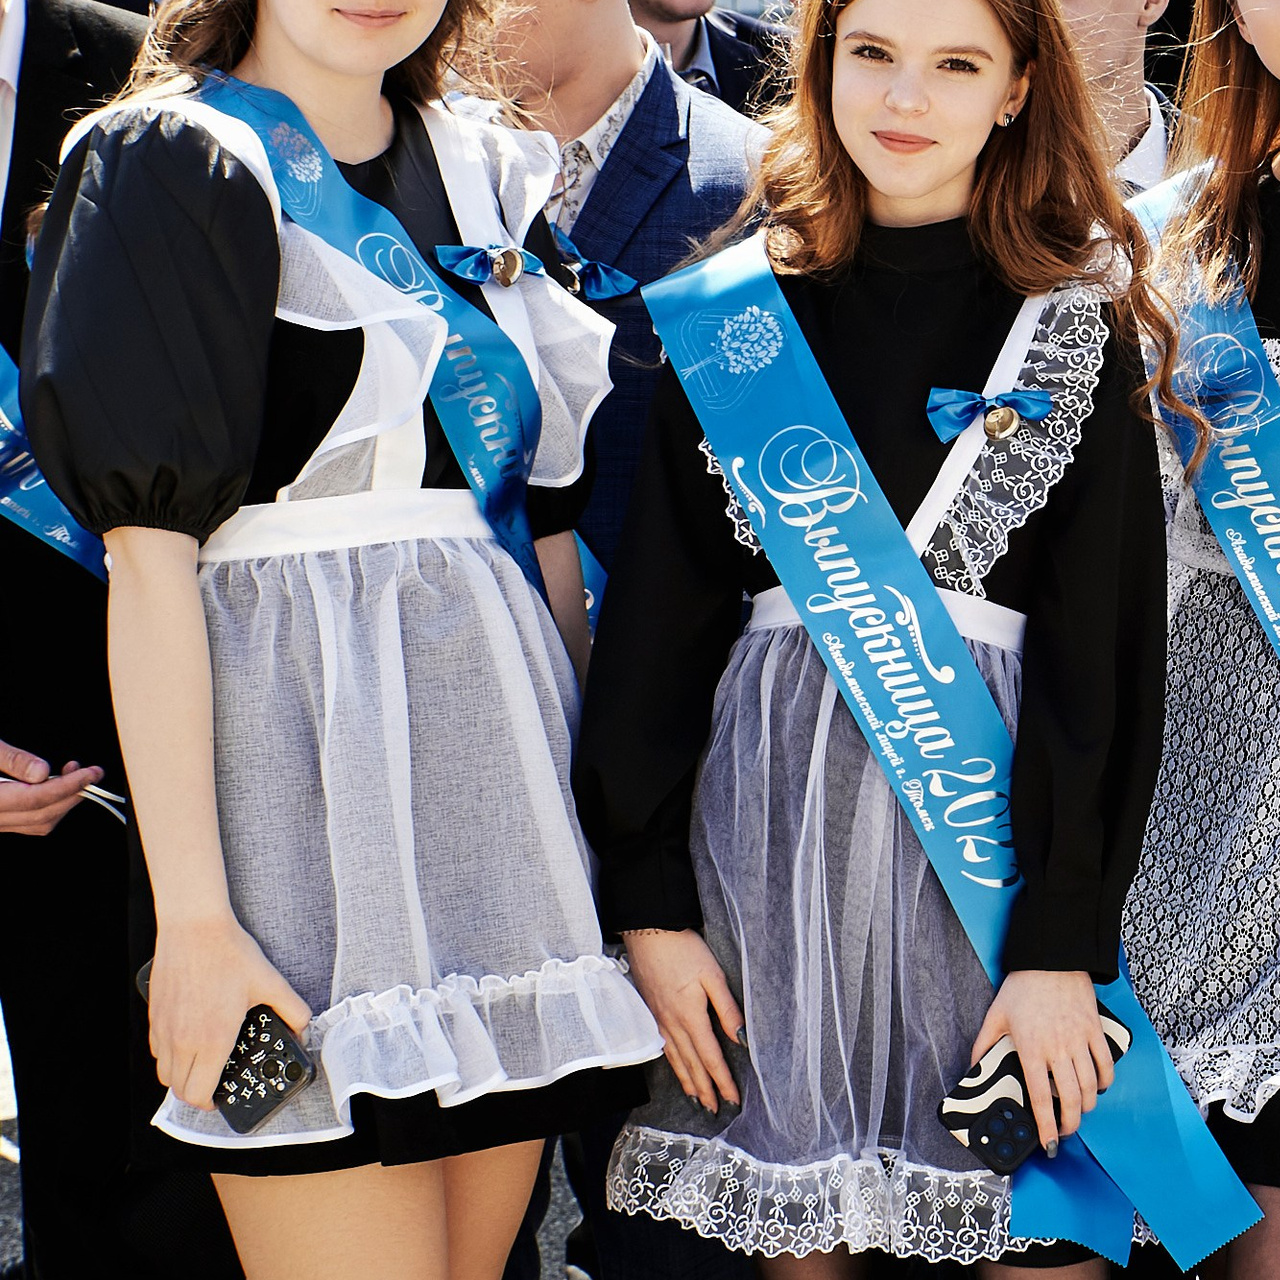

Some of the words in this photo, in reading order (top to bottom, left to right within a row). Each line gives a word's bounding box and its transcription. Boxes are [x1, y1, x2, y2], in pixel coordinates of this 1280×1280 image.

[758, 425, 956, 760] Выпускница
[1226, 528, 1280, 622] Академический
[822, 631, 884, 731] Академический
[875, 732, 905, 768] лицей
[902, 778, 935, 832] Томск
